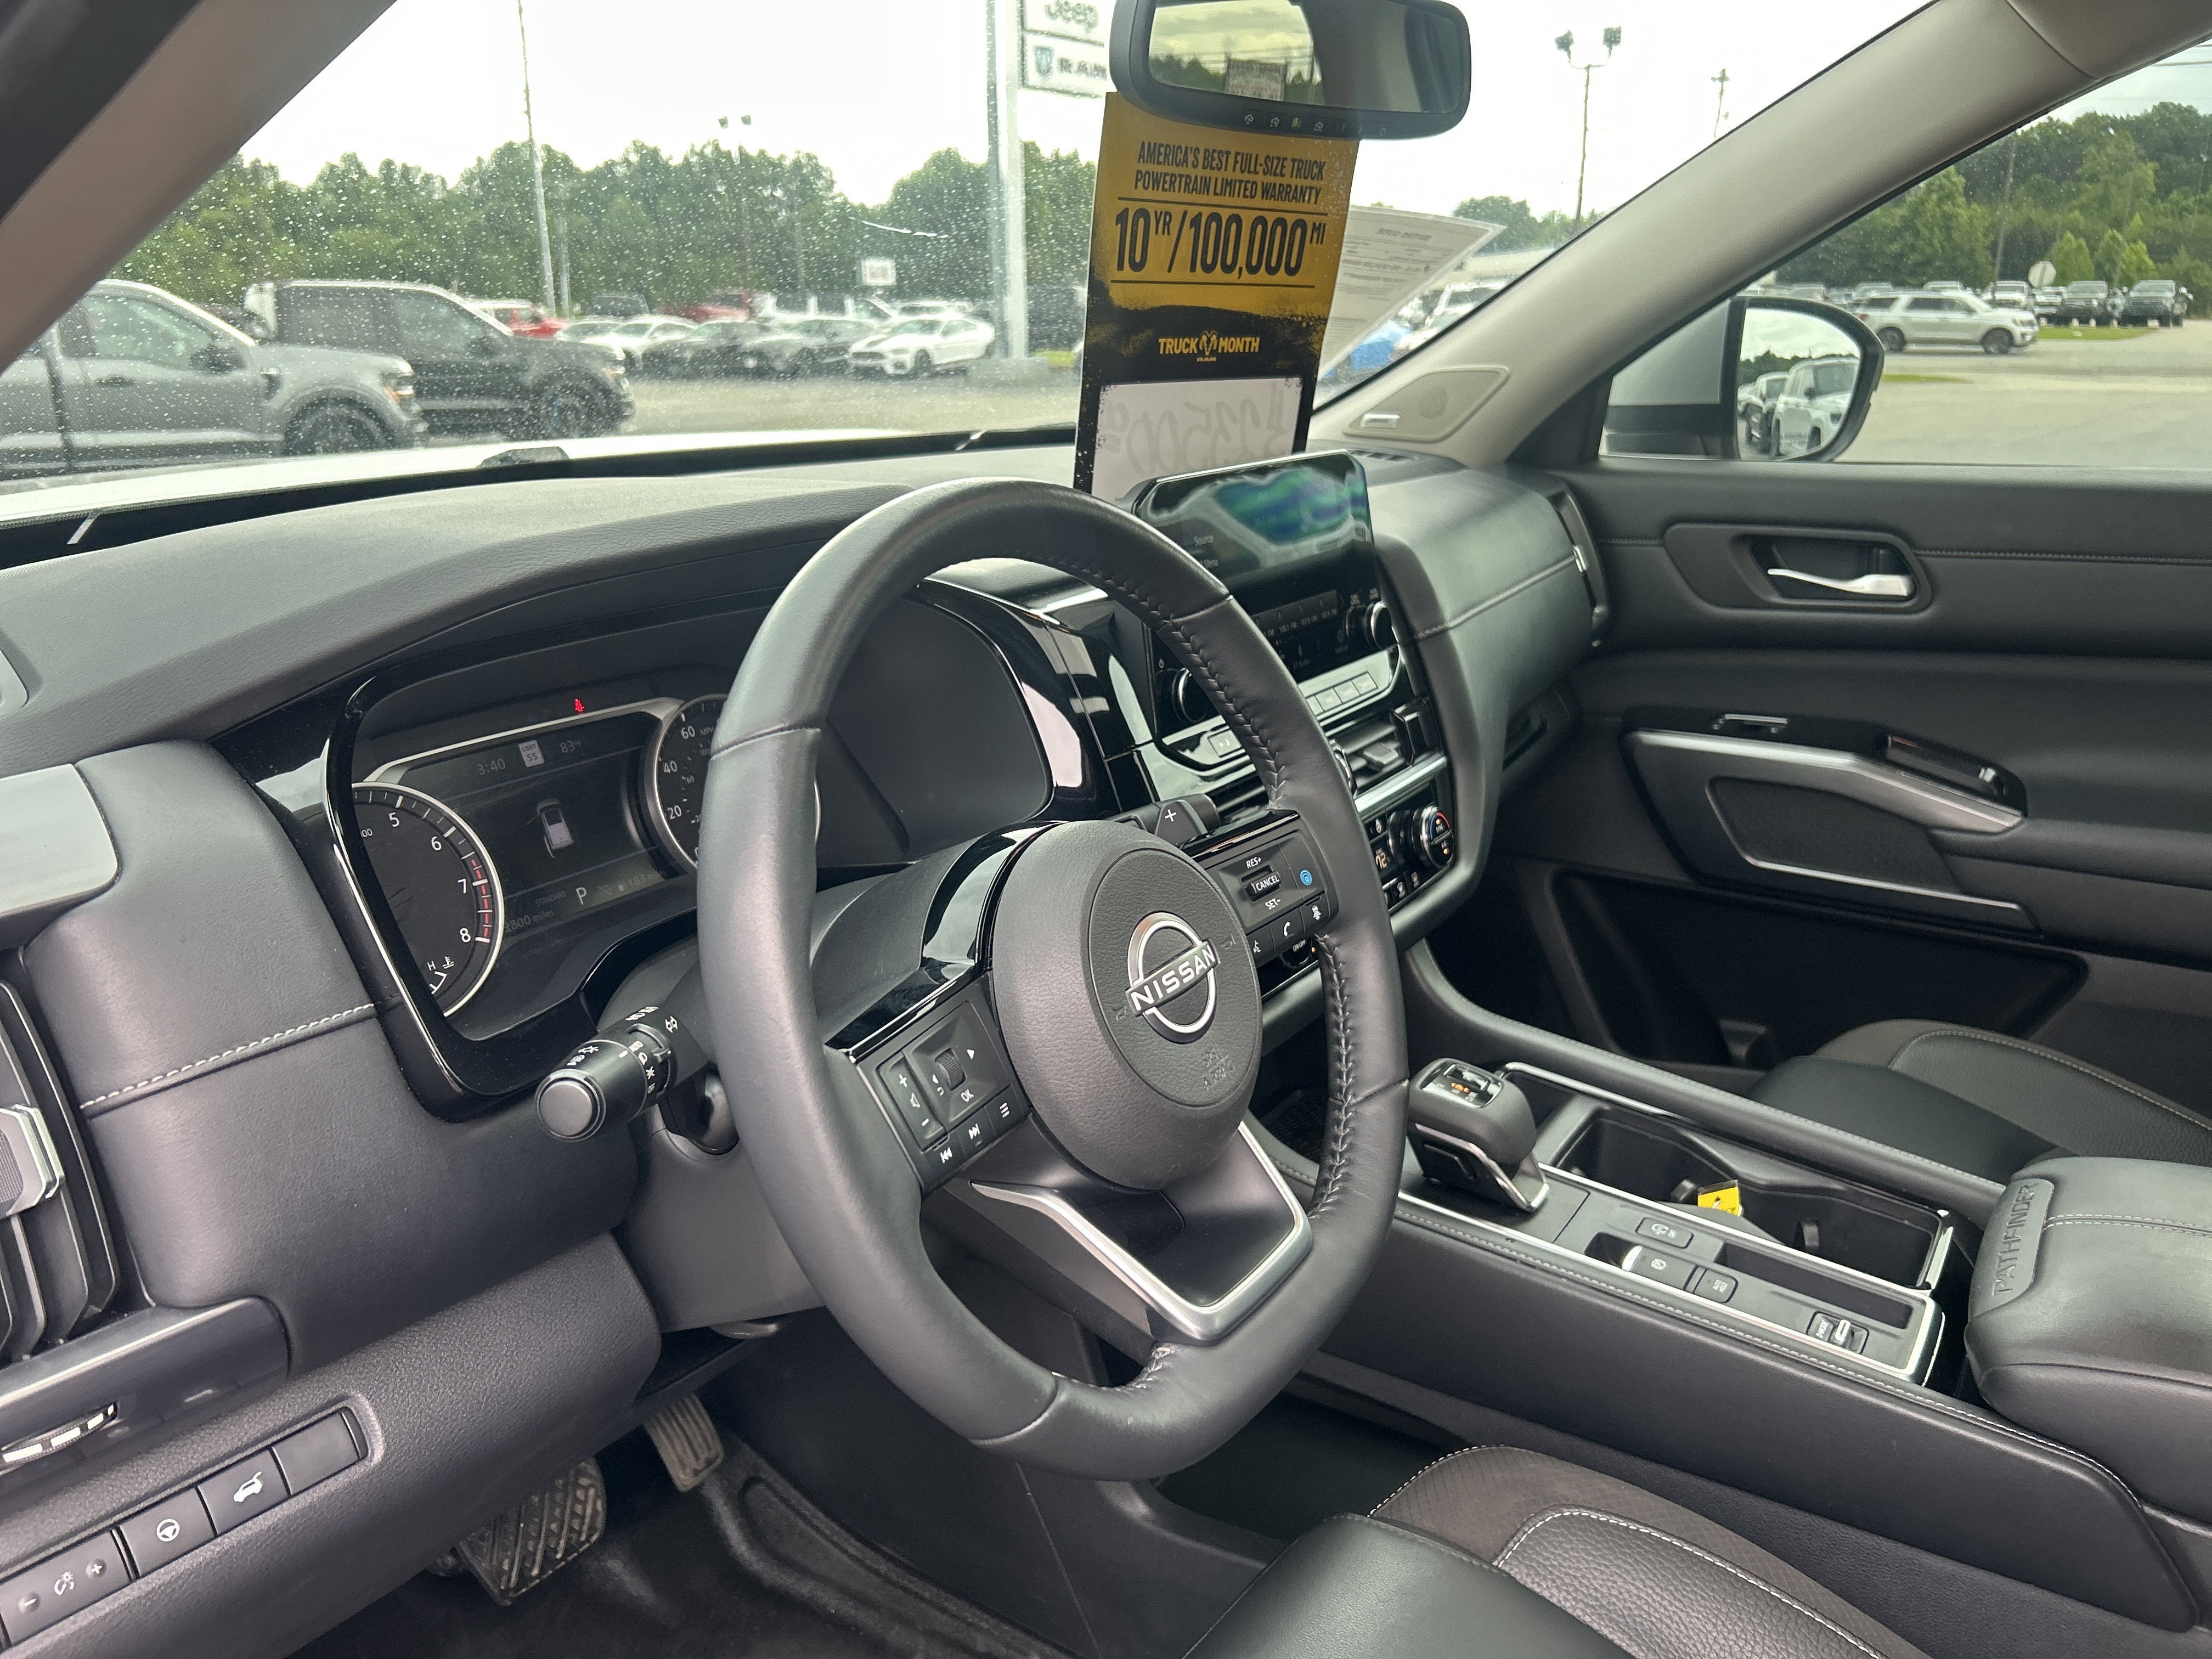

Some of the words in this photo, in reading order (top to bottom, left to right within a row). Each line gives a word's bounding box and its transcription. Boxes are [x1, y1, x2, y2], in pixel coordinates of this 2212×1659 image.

[1057, 57, 1107, 80] RAM
[1137, 140, 1200, 170] AMERICA'S
[1202, 148, 1231, 172] BEST
[1233, 151, 1288, 178] FULL-SIZE
[1290, 157, 1326, 182] TRUCK
[1134, 170, 1211, 196] POWERTRAIN
[1213, 176, 1258, 199] LIMITED
[1261, 181, 1322, 205] WARRANTY
[1158, 336, 1198, 354] TRUCK
[1218, 336, 1260, 353] MONTH
[1194, 534, 1214, 547] Source
[681, 725, 696, 740] 60
[521, 743, 537, 752] LIMIT
[526, 752, 538, 761] 55
[476, 758, 506, 775] 3:40
[663, 760, 678, 774] 40
[686, 775, 695, 785] 60
[388, 812, 400, 827] 5
[667, 804, 682, 820] 20
[431, 836, 442, 851] 6
[1246, 856, 1262, 869] RES+
[458, 878, 467, 894] 7
[628, 873, 646, 888] 183
[1256, 874, 1280, 891] CANCEL
[534, 890, 567, 907] STANDARD
[575, 886, 588, 905] P
[1265, 898, 1281, 910] SET-
[533, 909, 555, 922] miles
[459, 927, 471, 943] 8
[427, 960, 437, 972] H
[1130, 944, 1216, 1012] NISSAN
[960, 1088, 974, 1103] OK
[1991, 1183, 2039, 1296] PATHFINDER
